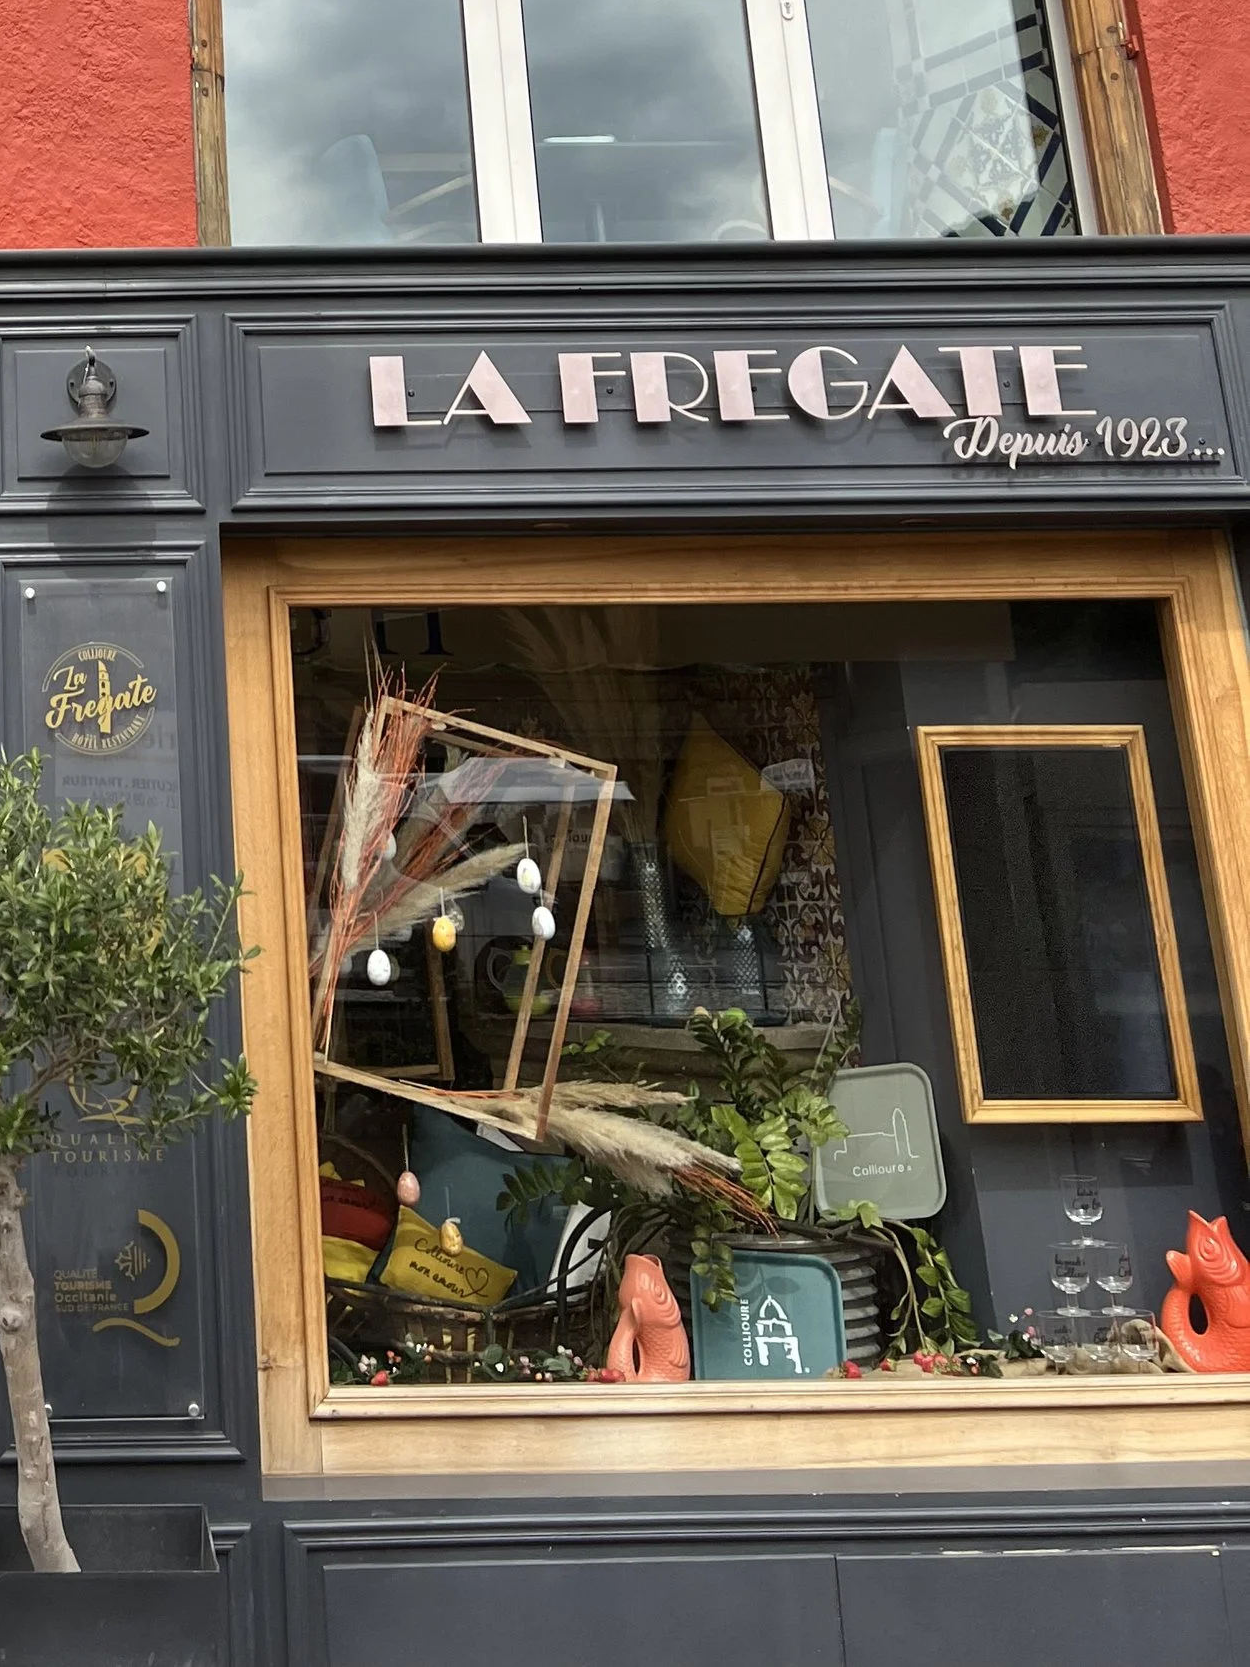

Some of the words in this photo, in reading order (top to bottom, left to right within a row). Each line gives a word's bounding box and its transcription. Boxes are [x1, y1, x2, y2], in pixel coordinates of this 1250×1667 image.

[368, 349, 533, 427] LA
[557, 344, 1097, 426] FREGATE
[942, 415, 1090, 470] Depuis
[53, 665, 88, 691] La
[45, 673, 158, 729] Fregate
[50, 1149, 165, 1163] TOURISME
[852, 1163, 905, 1177] Collioure
[409, 1260, 431, 1278] mon
[742, 1298, 754, 1366] COLLIOURE
